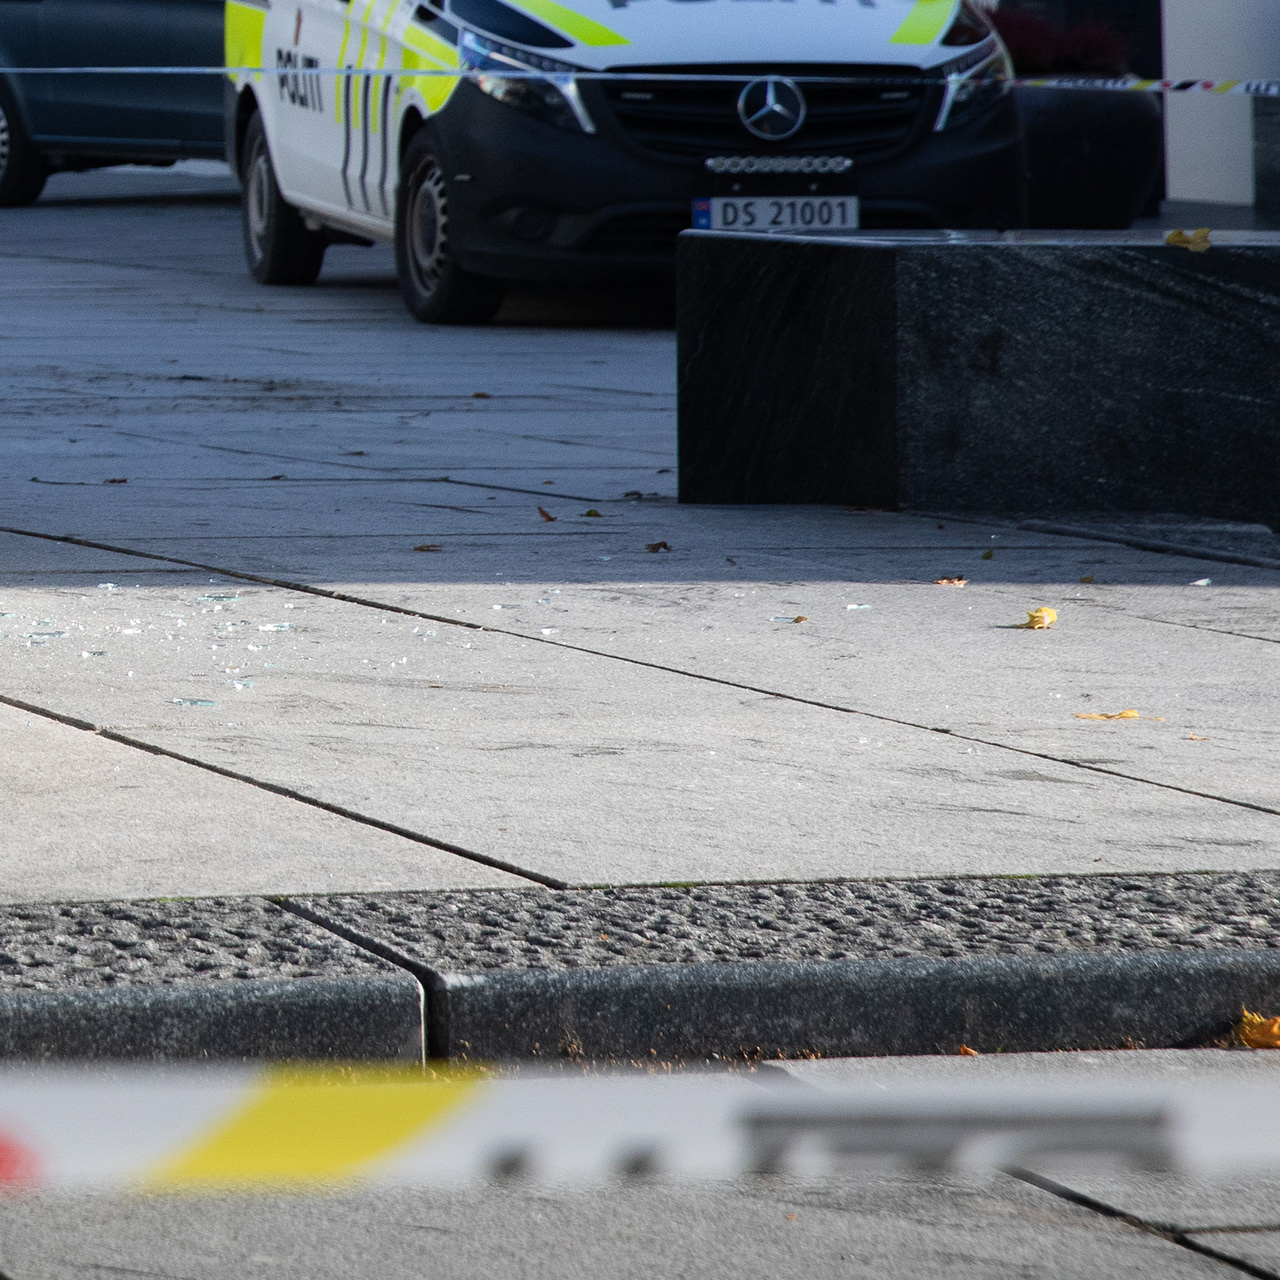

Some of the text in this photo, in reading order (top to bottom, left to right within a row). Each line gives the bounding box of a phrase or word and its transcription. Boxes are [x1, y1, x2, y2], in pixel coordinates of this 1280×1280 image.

[276, 47, 325, 114] POLITI
[722, 200, 847, 226] DS 21001
